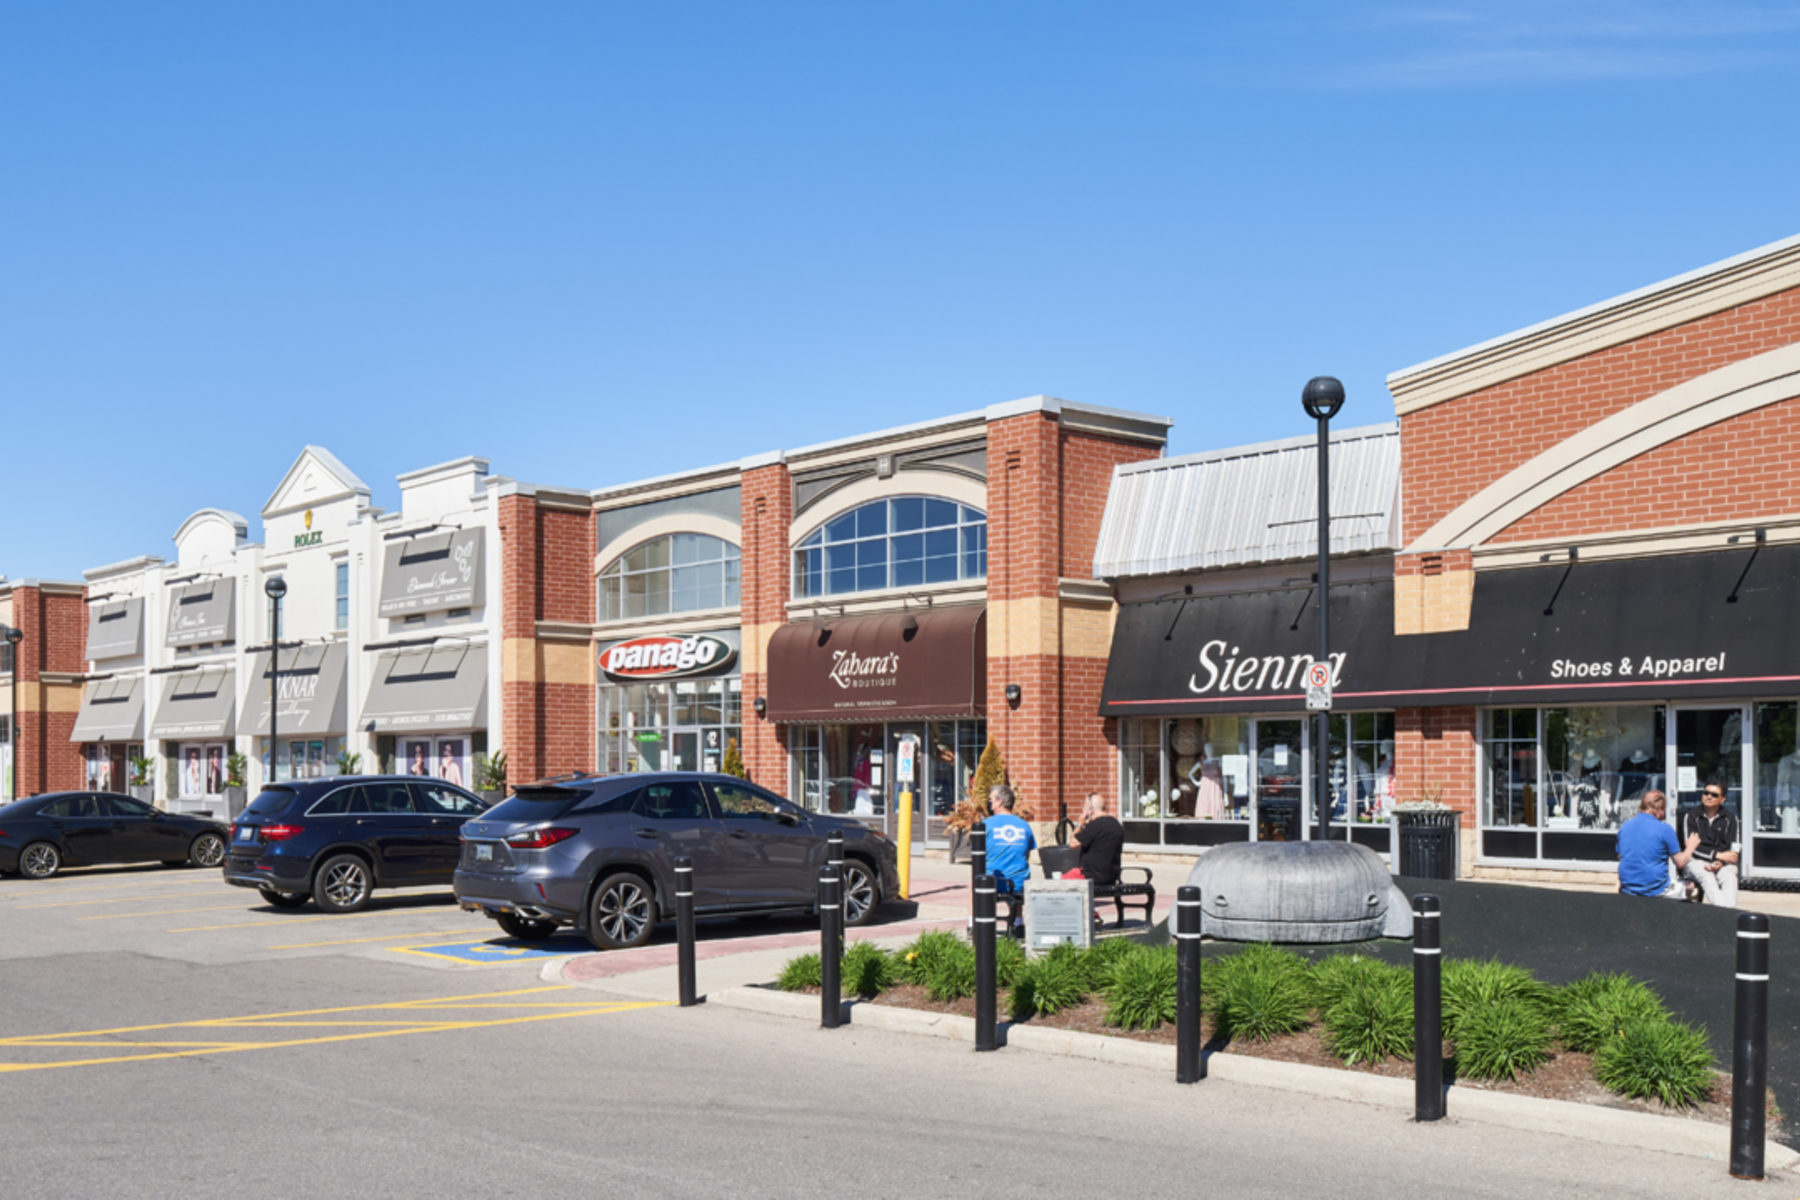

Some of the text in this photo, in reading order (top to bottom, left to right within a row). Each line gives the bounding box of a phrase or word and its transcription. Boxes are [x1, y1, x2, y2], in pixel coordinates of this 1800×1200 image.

[294, 530, 323, 548] ROLEX
[606, 635, 720, 673] panago
[1550, 651, 1726, 678] Shoes & Apparel
[828, 650, 900, 689] Zahara's
[852, 677, 897, 688] BOUTIQUE
